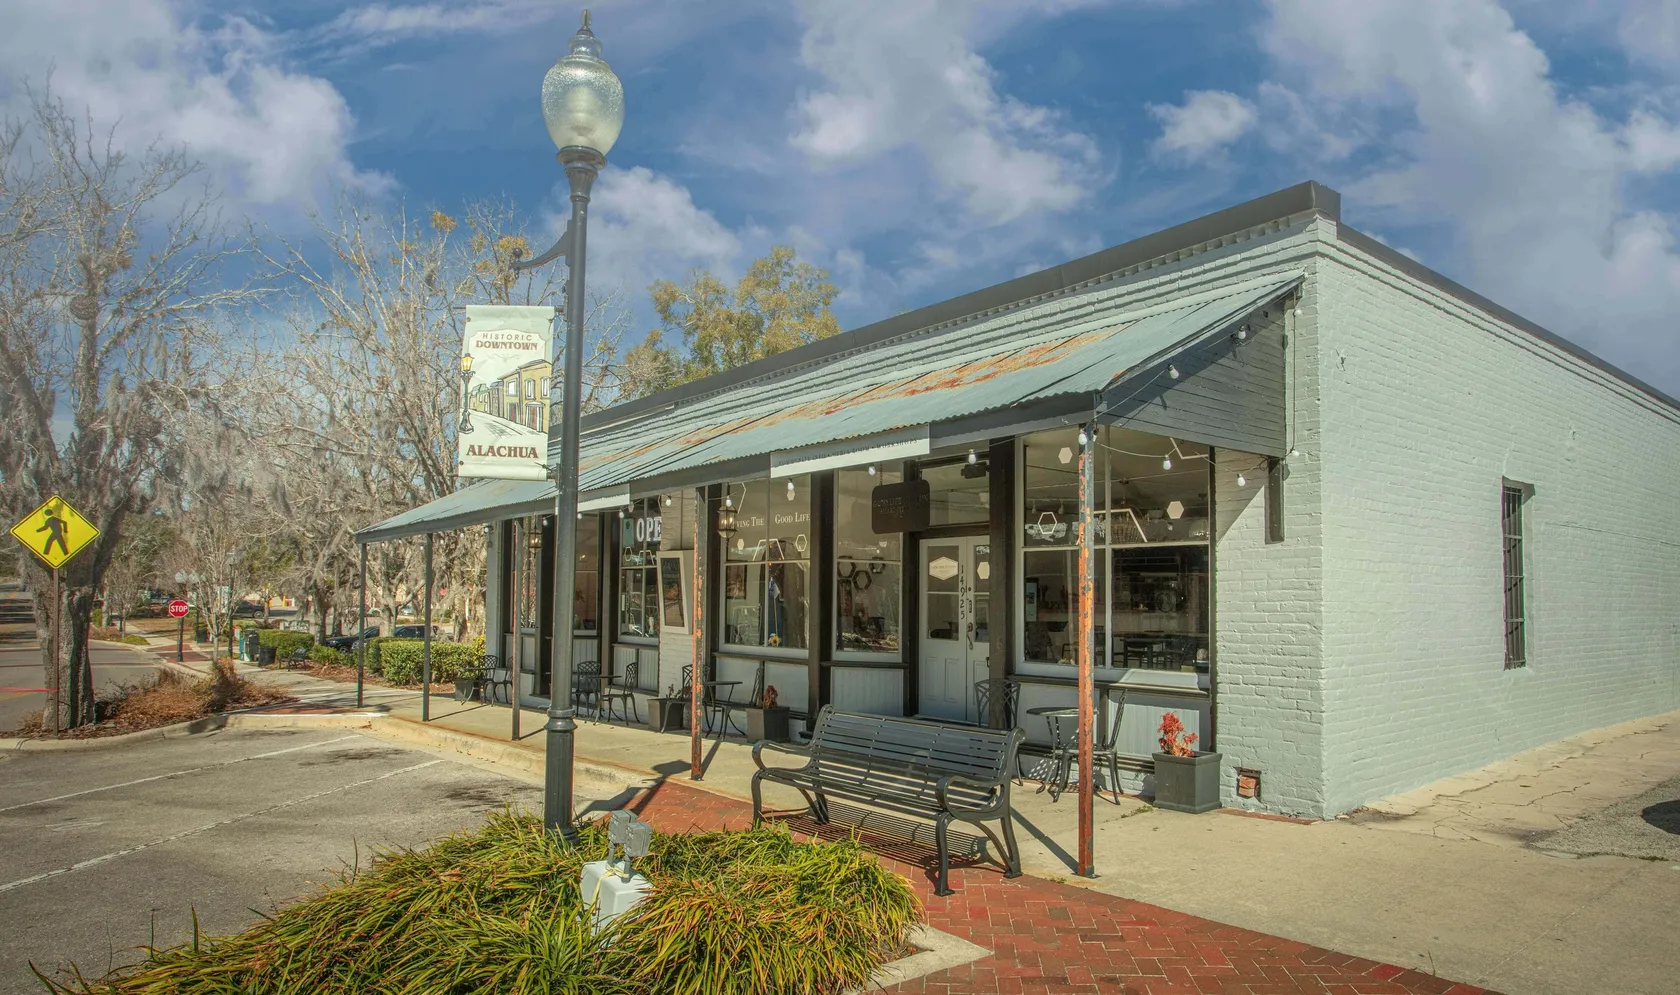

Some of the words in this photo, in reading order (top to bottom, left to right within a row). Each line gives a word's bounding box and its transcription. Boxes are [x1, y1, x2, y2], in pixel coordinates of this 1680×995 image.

[482, 332, 533, 342] HISTORIC
[475, 340, 538, 350] DOWNTOWN
[466, 444, 540, 459] ALACHUA
[774, 513, 793, 525] GOOD
[636, 516, 662, 542] OPE
[170, 605, 188, 613] STOP
